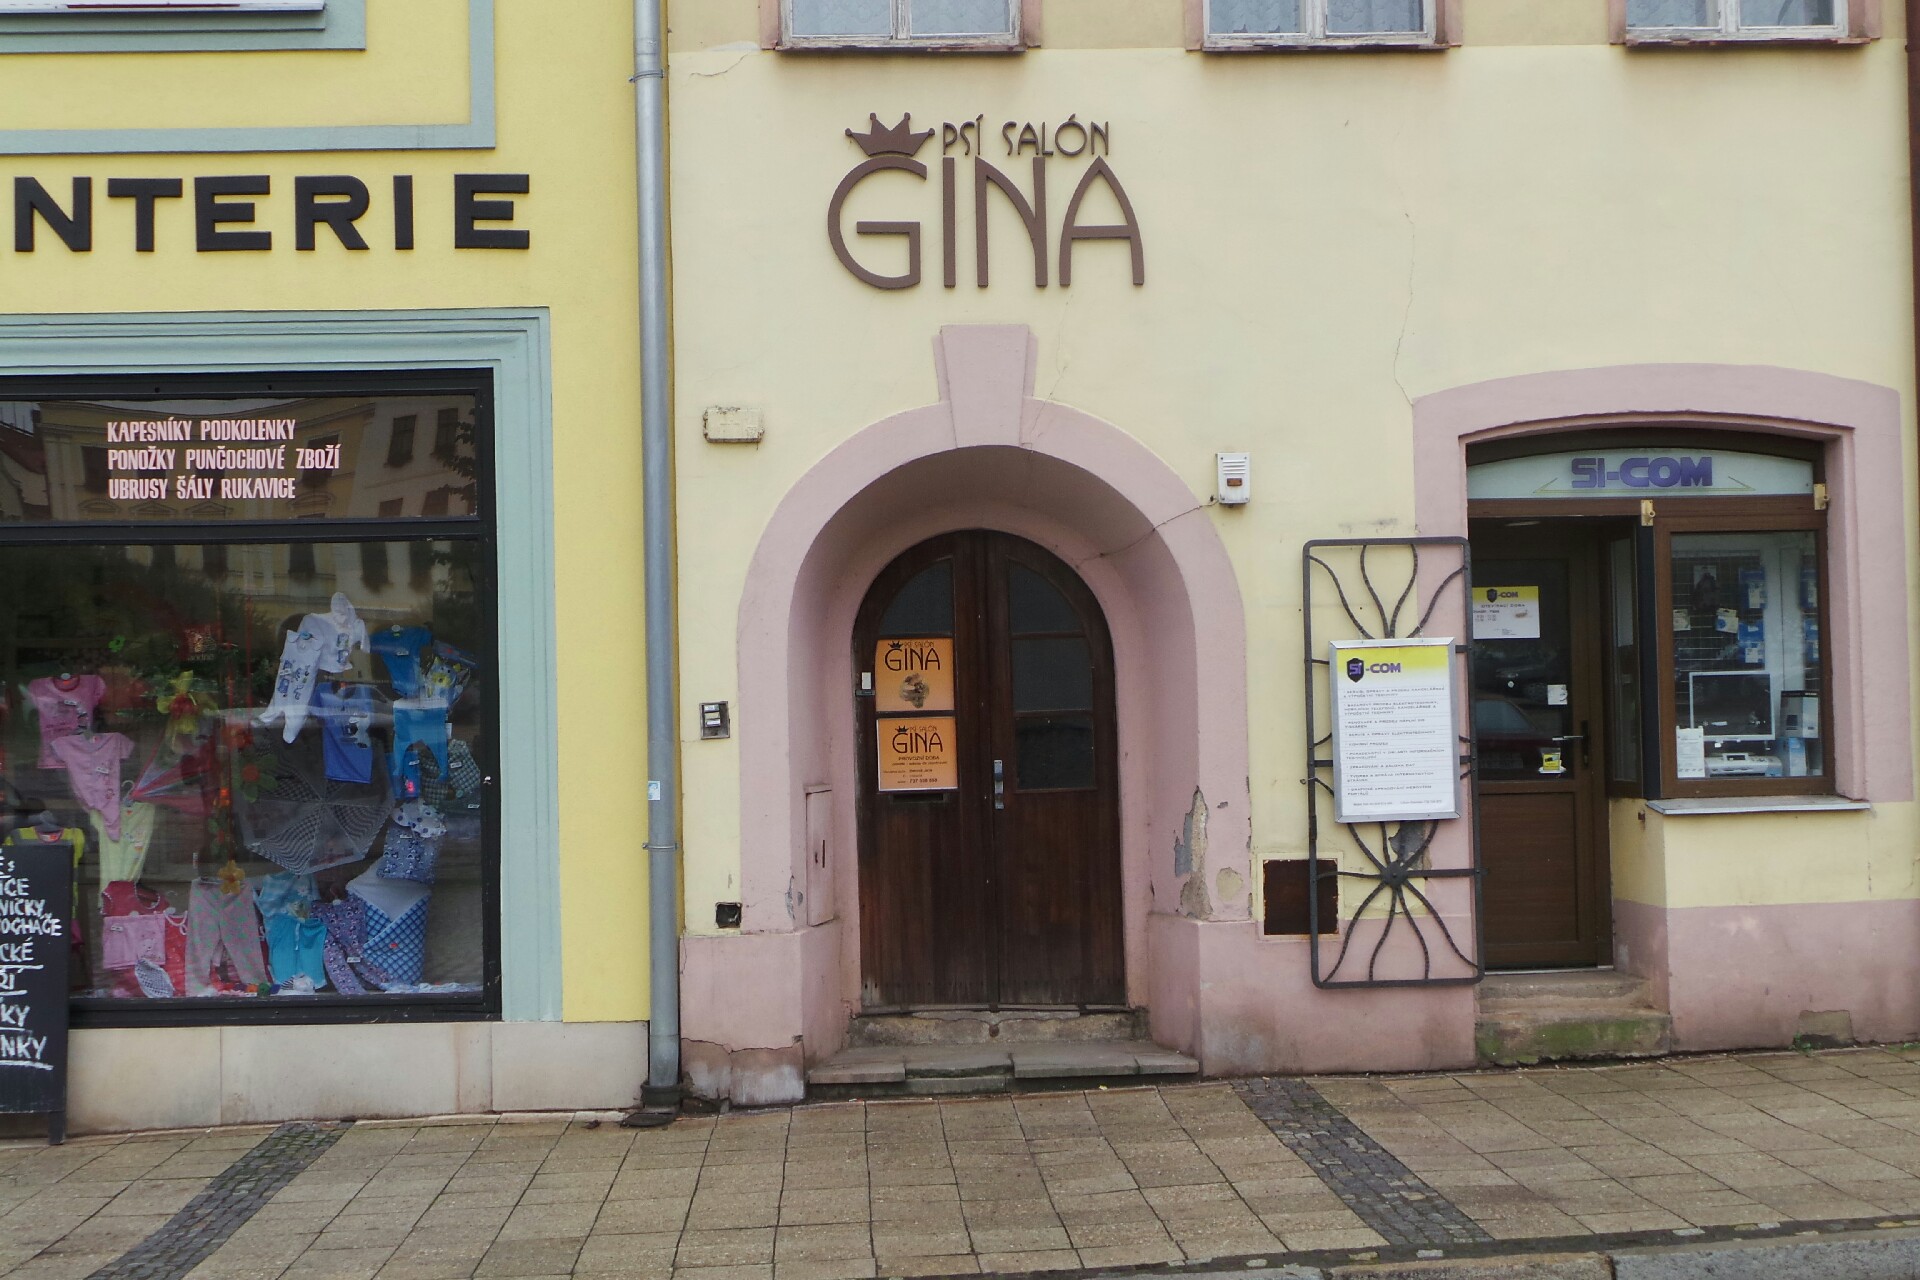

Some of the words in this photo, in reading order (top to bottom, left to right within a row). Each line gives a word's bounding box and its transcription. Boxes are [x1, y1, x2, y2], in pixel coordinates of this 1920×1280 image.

[943, 114, 983, 156] PSÍ
[1002, 114, 1109, 156] SALÓN
[14, 174, 530, 252] NTERIE
[828, 155, 1145, 292] GINA
[108, 417, 191, 442] KAPESNÍKY
[201, 420, 295, 440] PODKOLENKY
[109, 445, 175, 470] PONOŽKY
[186, 445, 285, 470] PUNČOCHOVÉ
[296, 444, 340, 469] ZBOŽÍ
[1571, 457, 1712, 488] SI-COM
[109, 478, 168, 499] UBRUSY
[176, 475, 214, 499] ŠÁLY
[221, 478, 295, 499] RUKAVICE
[884, 646, 940, 671] GINA
[892, 732, 943, 754] GINA
